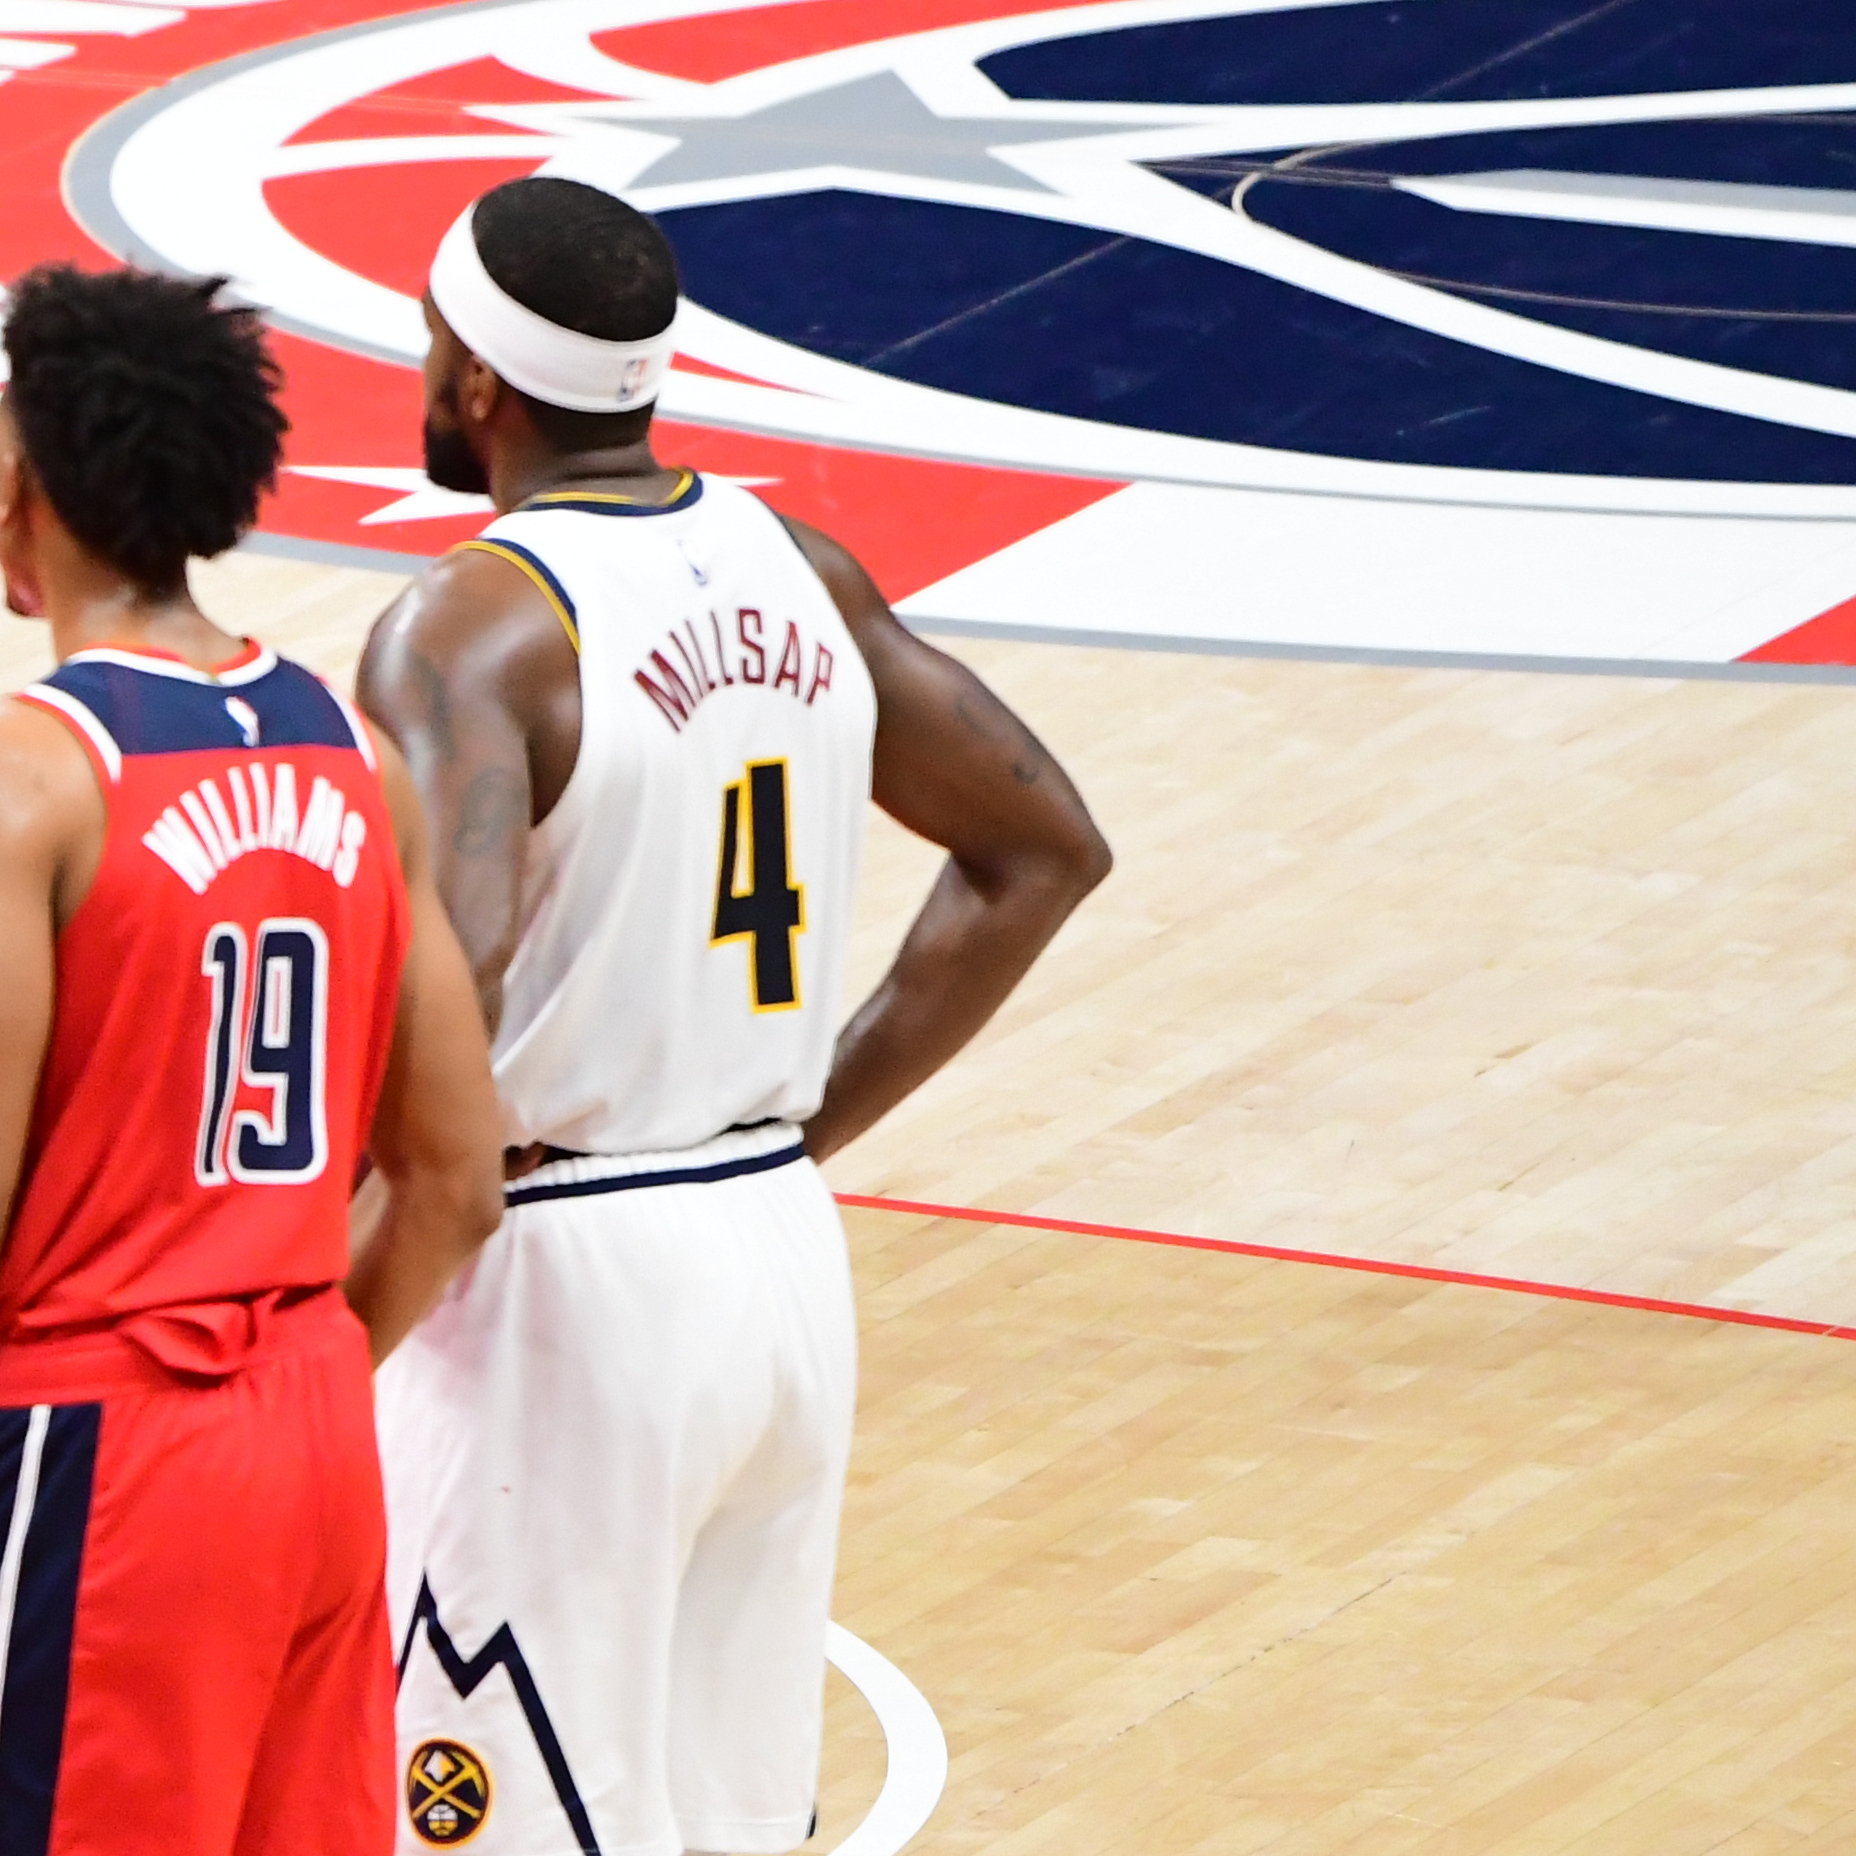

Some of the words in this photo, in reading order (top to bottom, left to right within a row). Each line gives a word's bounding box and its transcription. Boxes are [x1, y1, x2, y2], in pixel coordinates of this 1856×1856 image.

[632, 607, 835, 735] MILLSAP
[142, 762, 368, 896] WILLIAMS
[708, 755, 806, 1014] 4
[192, 917, 330, 1187] 19
